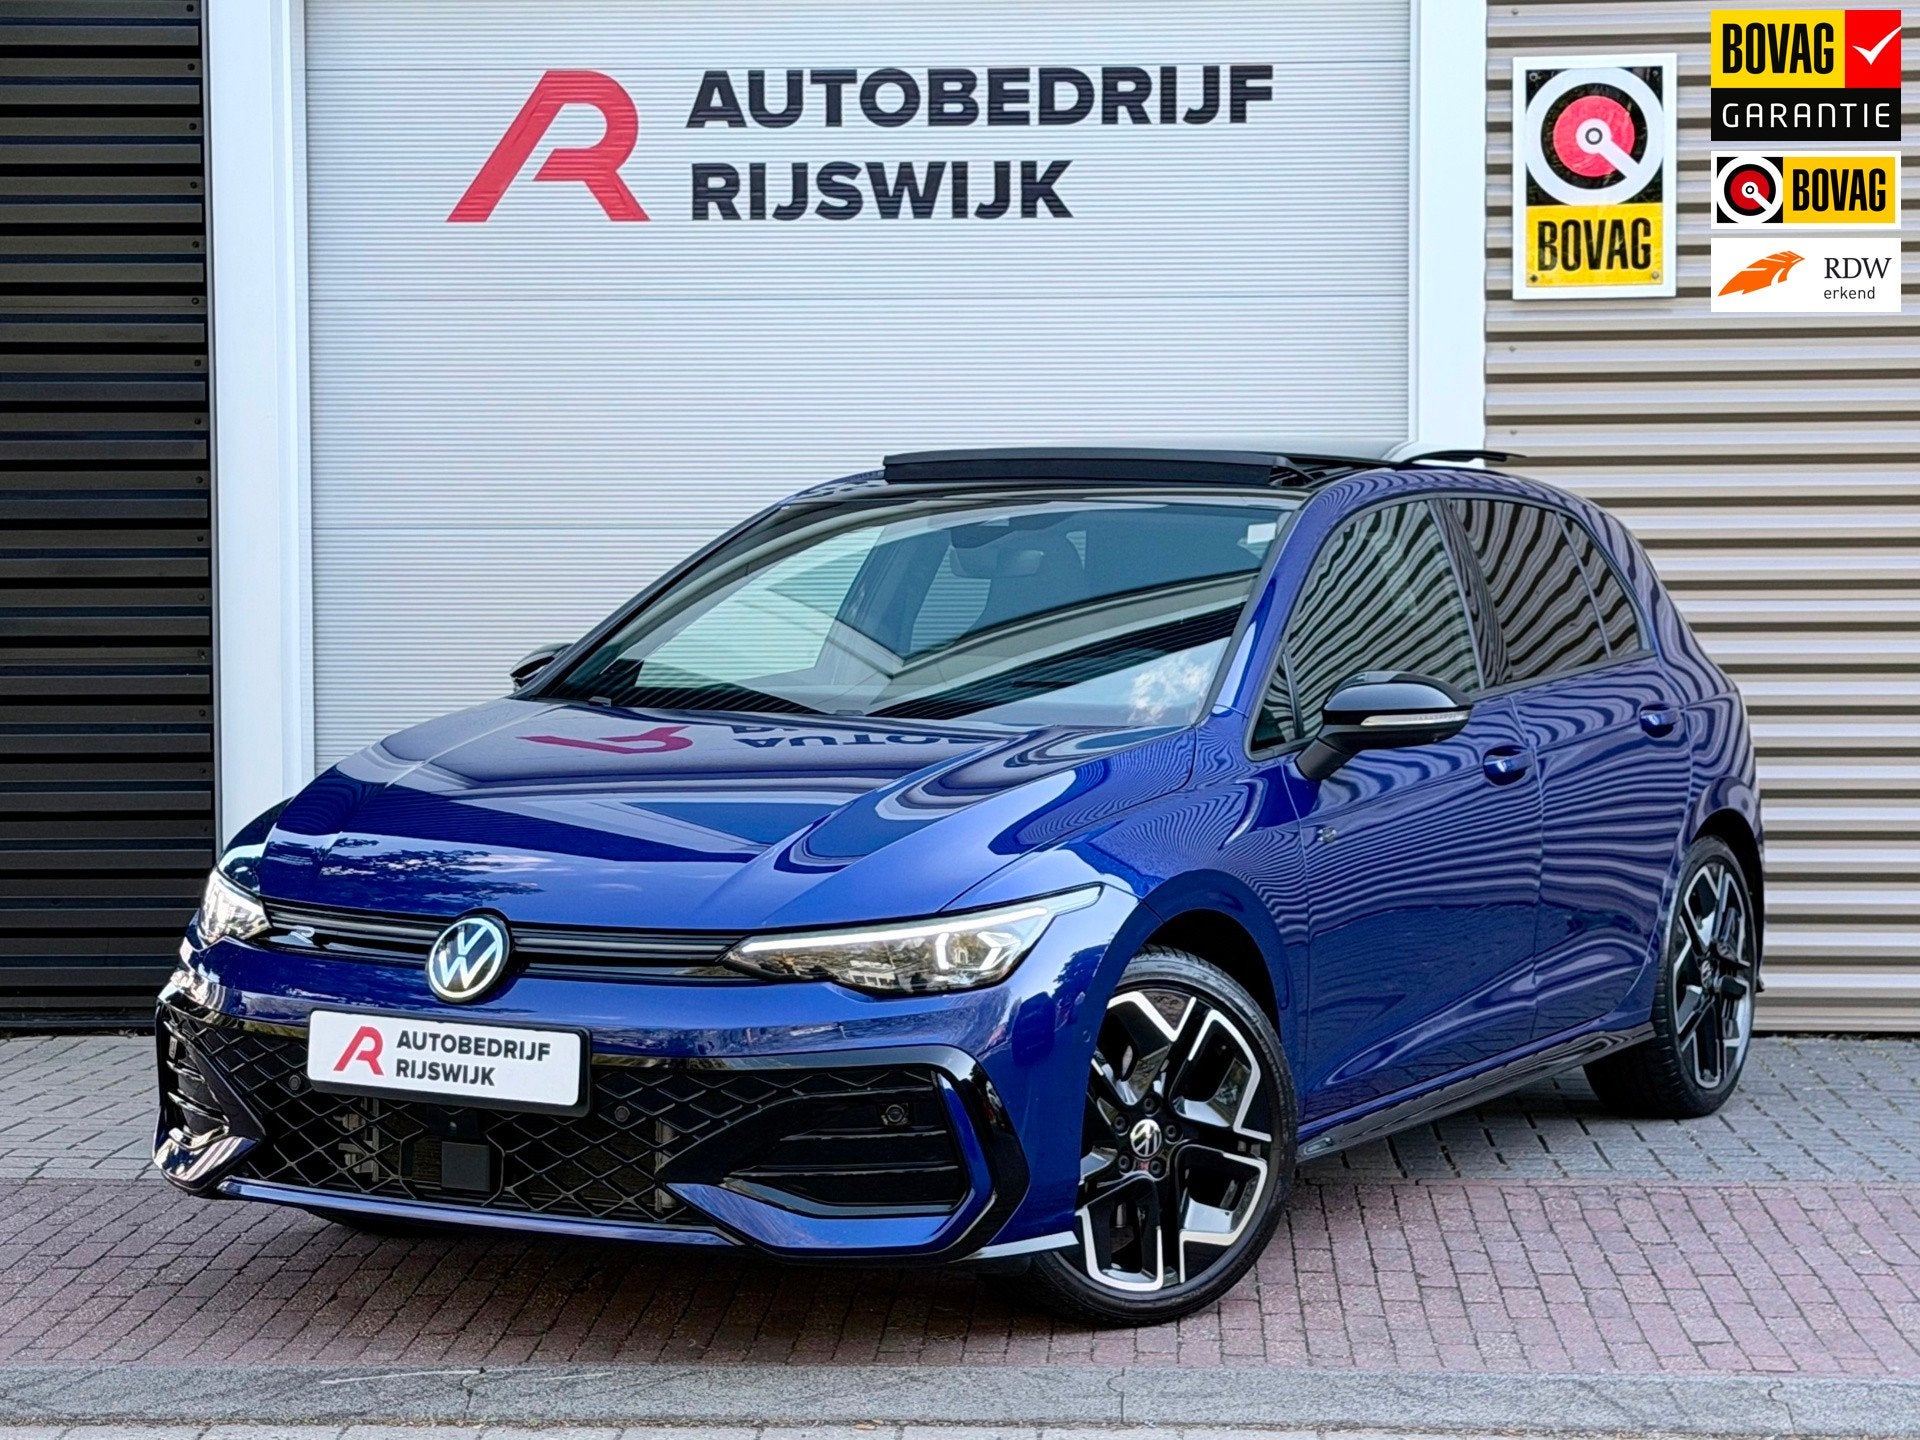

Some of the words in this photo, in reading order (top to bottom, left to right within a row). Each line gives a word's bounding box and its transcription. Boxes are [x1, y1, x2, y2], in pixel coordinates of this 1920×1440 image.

[686, 65, 1273, 128] AUTOBEDRIJF
[691, 160, 1073, 221] RIJSWIJK
[1537, 217, 1652, 271] BOVAG
[395, 1058, 496, 1087] RIJSWIJK
[396, 1030, 551, 1062] AUTOBEDRIJF
